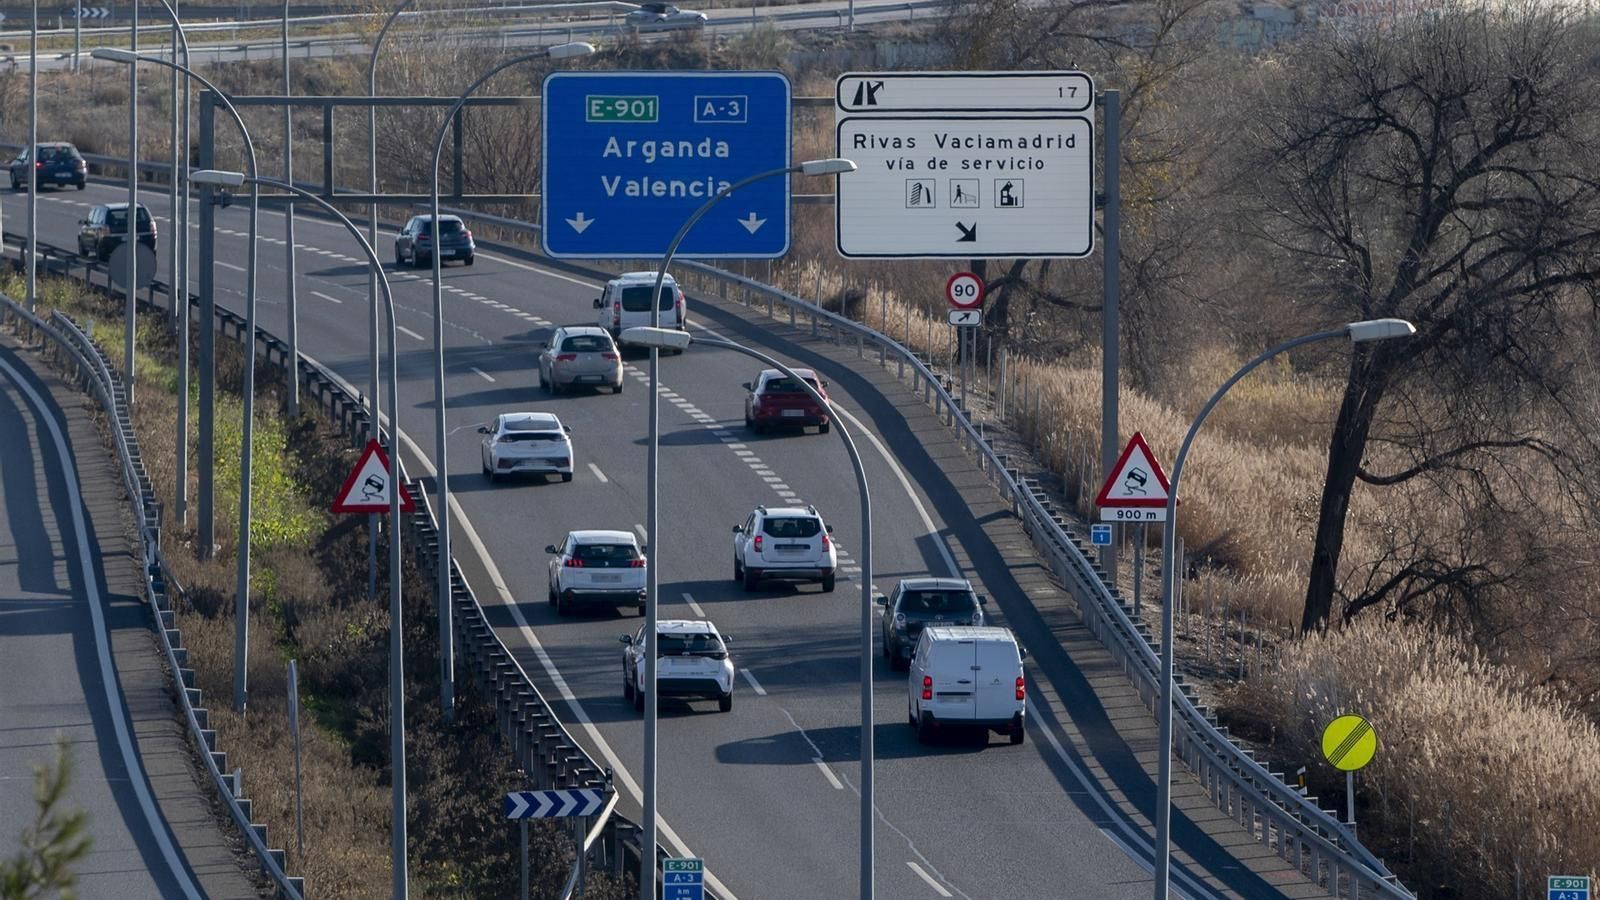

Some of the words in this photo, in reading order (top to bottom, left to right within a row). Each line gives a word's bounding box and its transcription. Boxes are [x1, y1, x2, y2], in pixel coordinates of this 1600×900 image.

[1058, 86, 1077, 98] 17
[590, 100, 655, 117] E-901
[703, 100, 740, 117] A-3
[853, 133, 916, 149] Rivas
[934, 133, 1076, 149] Vaciamadrid
[602, 136, 729, 164] Arganda
[886, 156, 915, 170] vía
[927, 156, 948, 170] de
[961, 156, 1045, 170] servicio
[601, 176, 732, 197] Valencia
[954, 284, 975, 297] 90
[1116, 510, 1141, 520] 900
[1146, 511, 1157, 520] m
[668, 861, 699, 870] E-901
[673, 873, 694, 883] A-3
[1553, 879, 1584, 888] E-901
[1558, 891, 1579, 900] A-3
